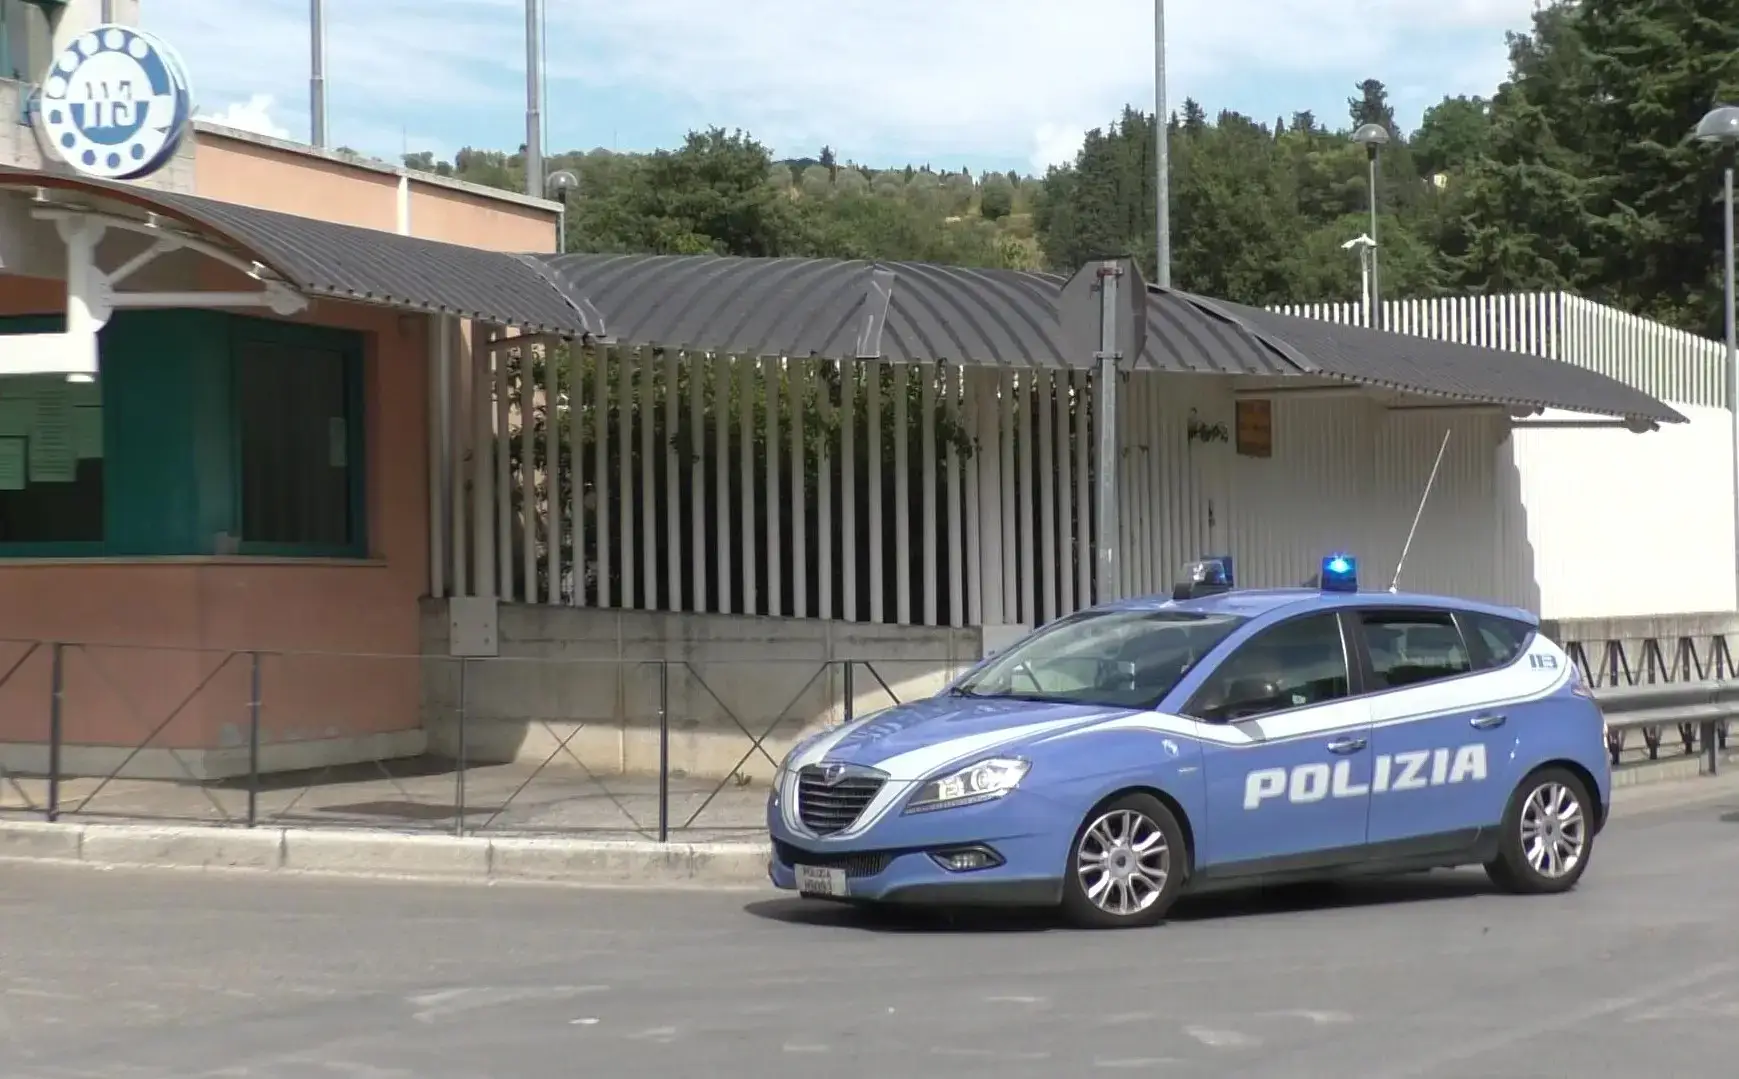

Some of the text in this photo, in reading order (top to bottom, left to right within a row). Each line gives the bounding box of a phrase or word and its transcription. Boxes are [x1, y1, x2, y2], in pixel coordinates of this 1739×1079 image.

[84, 80, 136, 129] 113
[1528, 653, 1557, 669] 113
[1243, 743, 1488, 810] POLIZIA
[802, 866, 831, 878] POLIZIA
